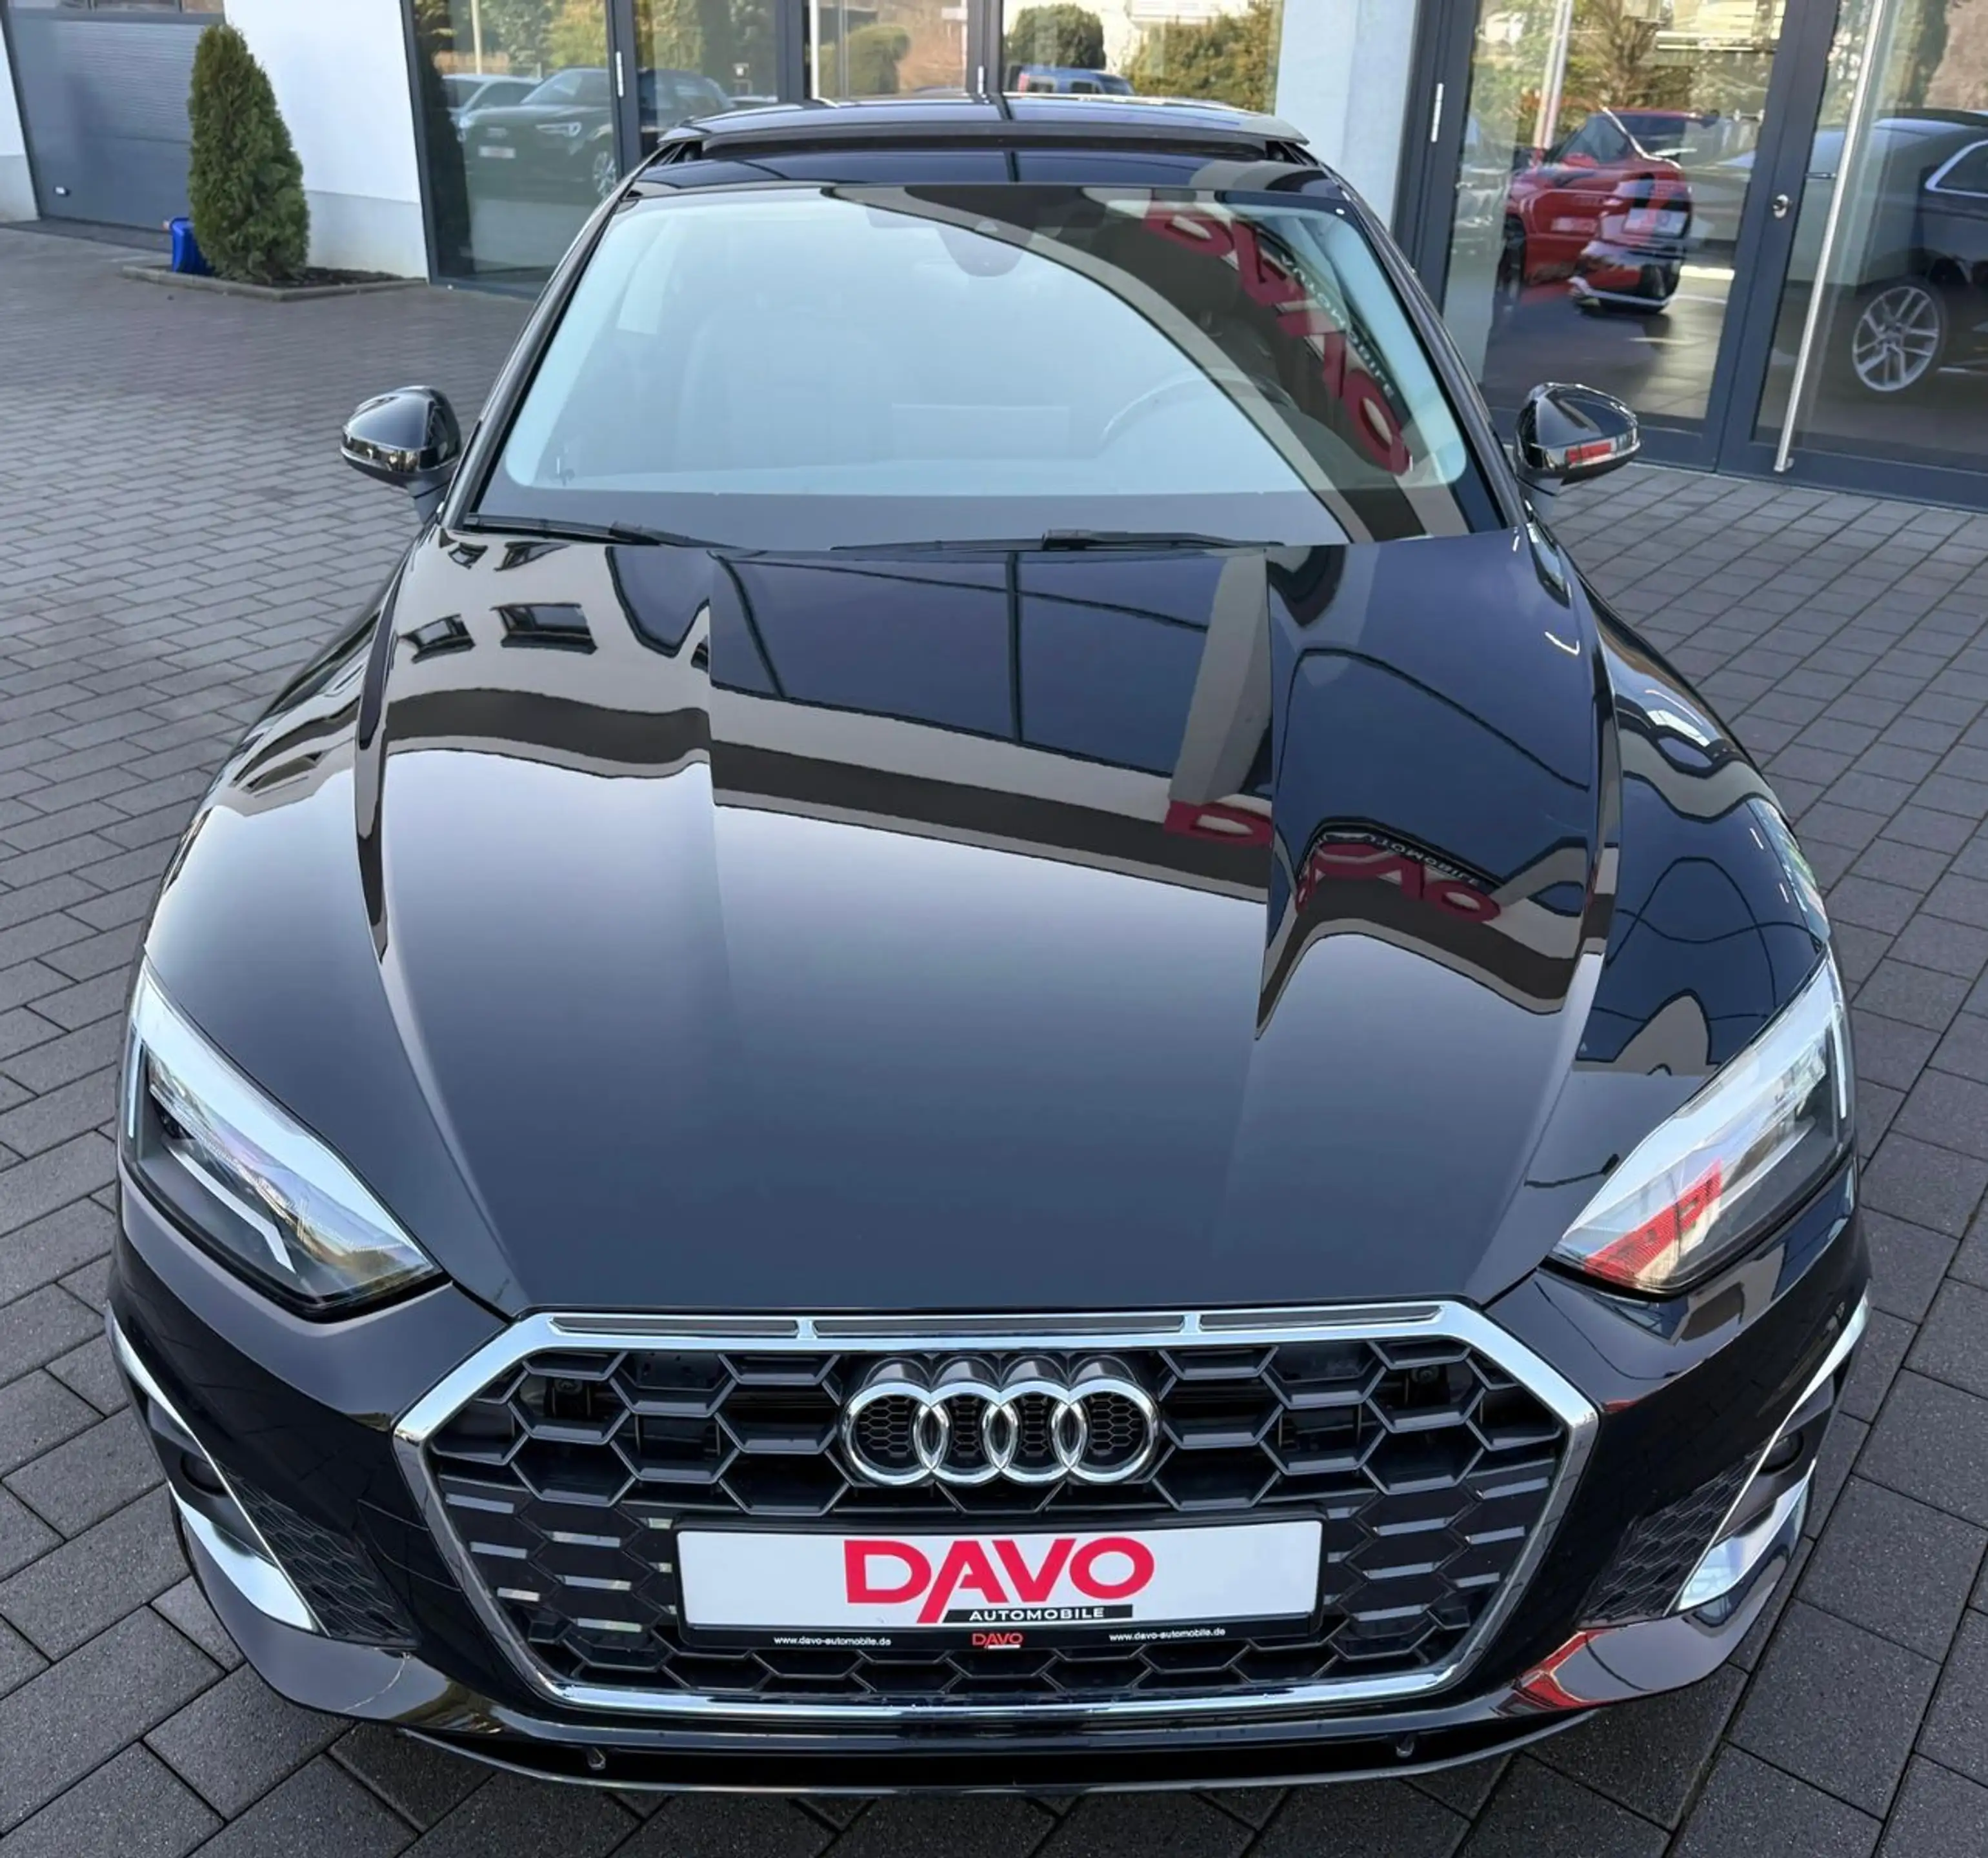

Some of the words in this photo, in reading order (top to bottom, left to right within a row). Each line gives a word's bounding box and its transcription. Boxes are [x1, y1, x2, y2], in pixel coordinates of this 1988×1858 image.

[843, 1537, 1155, 1624] DAVO
[969, 1607, 1105, 1622] AUTOMOBILE
[774, 1636, 892, 1646] www.davo-automobile.de
[972, 1632, 1023, 1648] DAVO
[1109, 1627, 1226, 1642] www.davo-automobile.de
